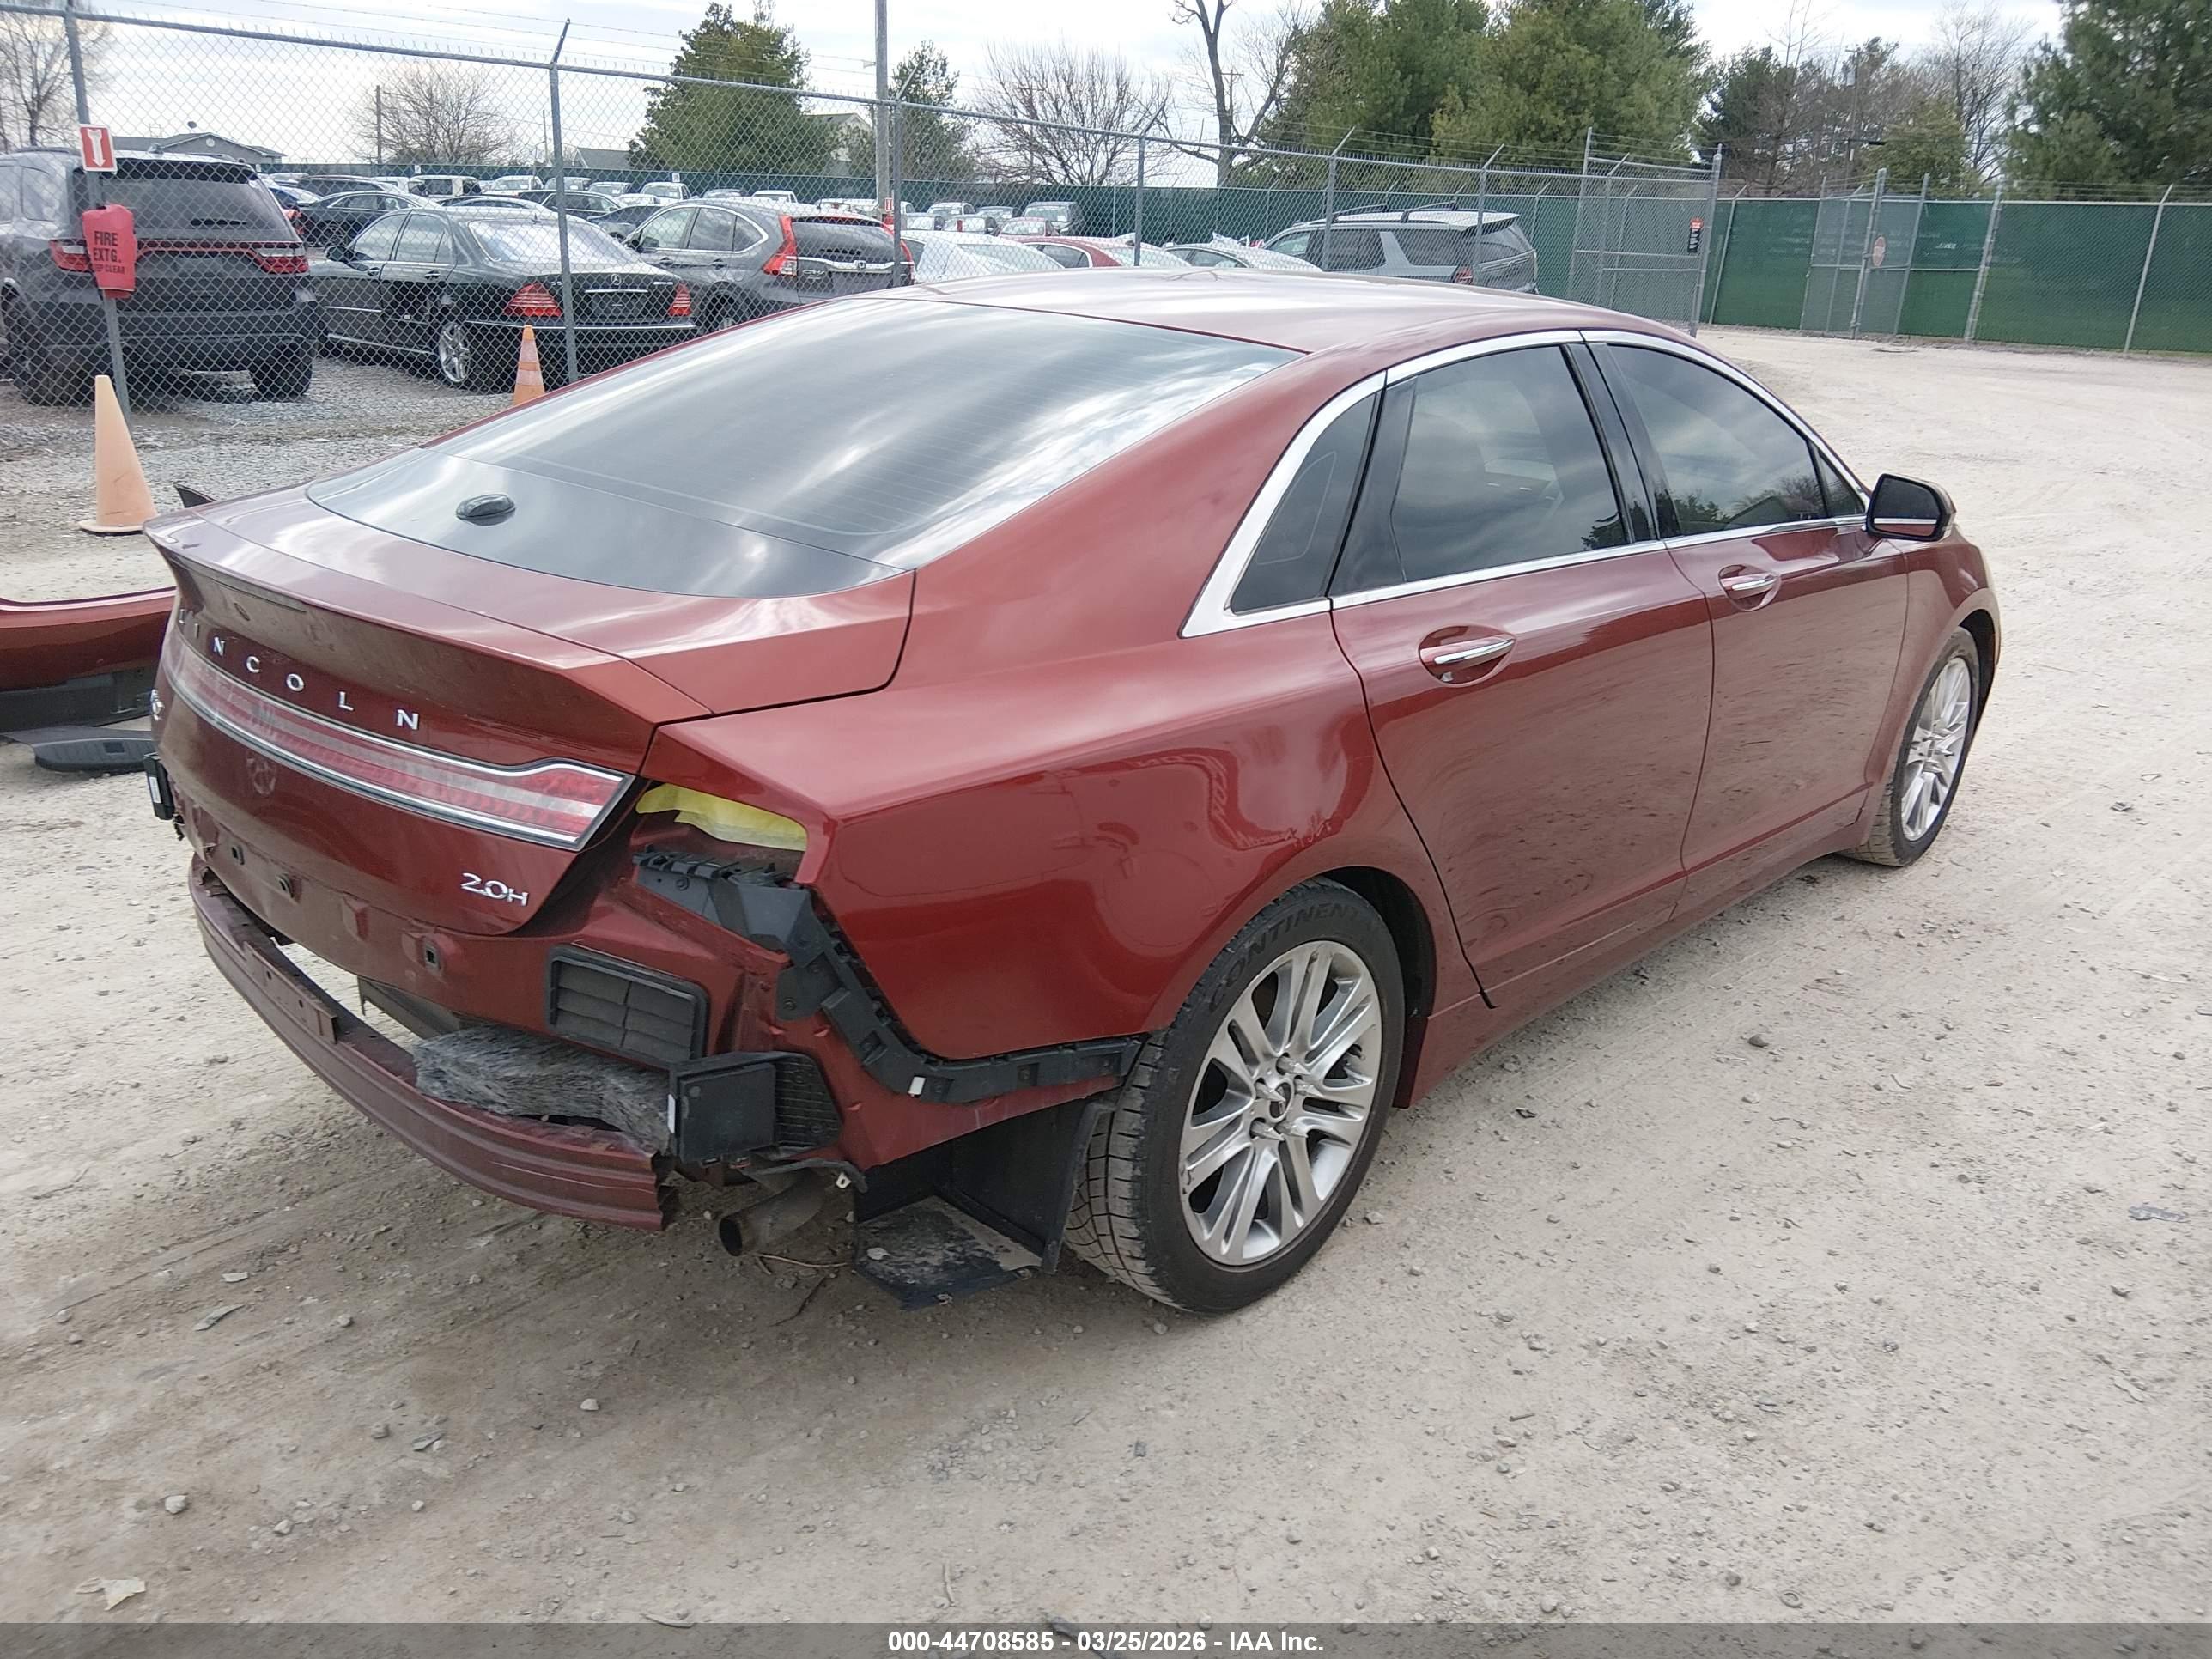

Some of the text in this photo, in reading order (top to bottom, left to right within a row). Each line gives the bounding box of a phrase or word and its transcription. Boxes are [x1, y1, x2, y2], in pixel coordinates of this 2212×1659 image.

[94, 230, 118, 246] FIRE
[93, 246, 122, 264] EXTG.
[179, 608, 419, 730] LINCOLN
